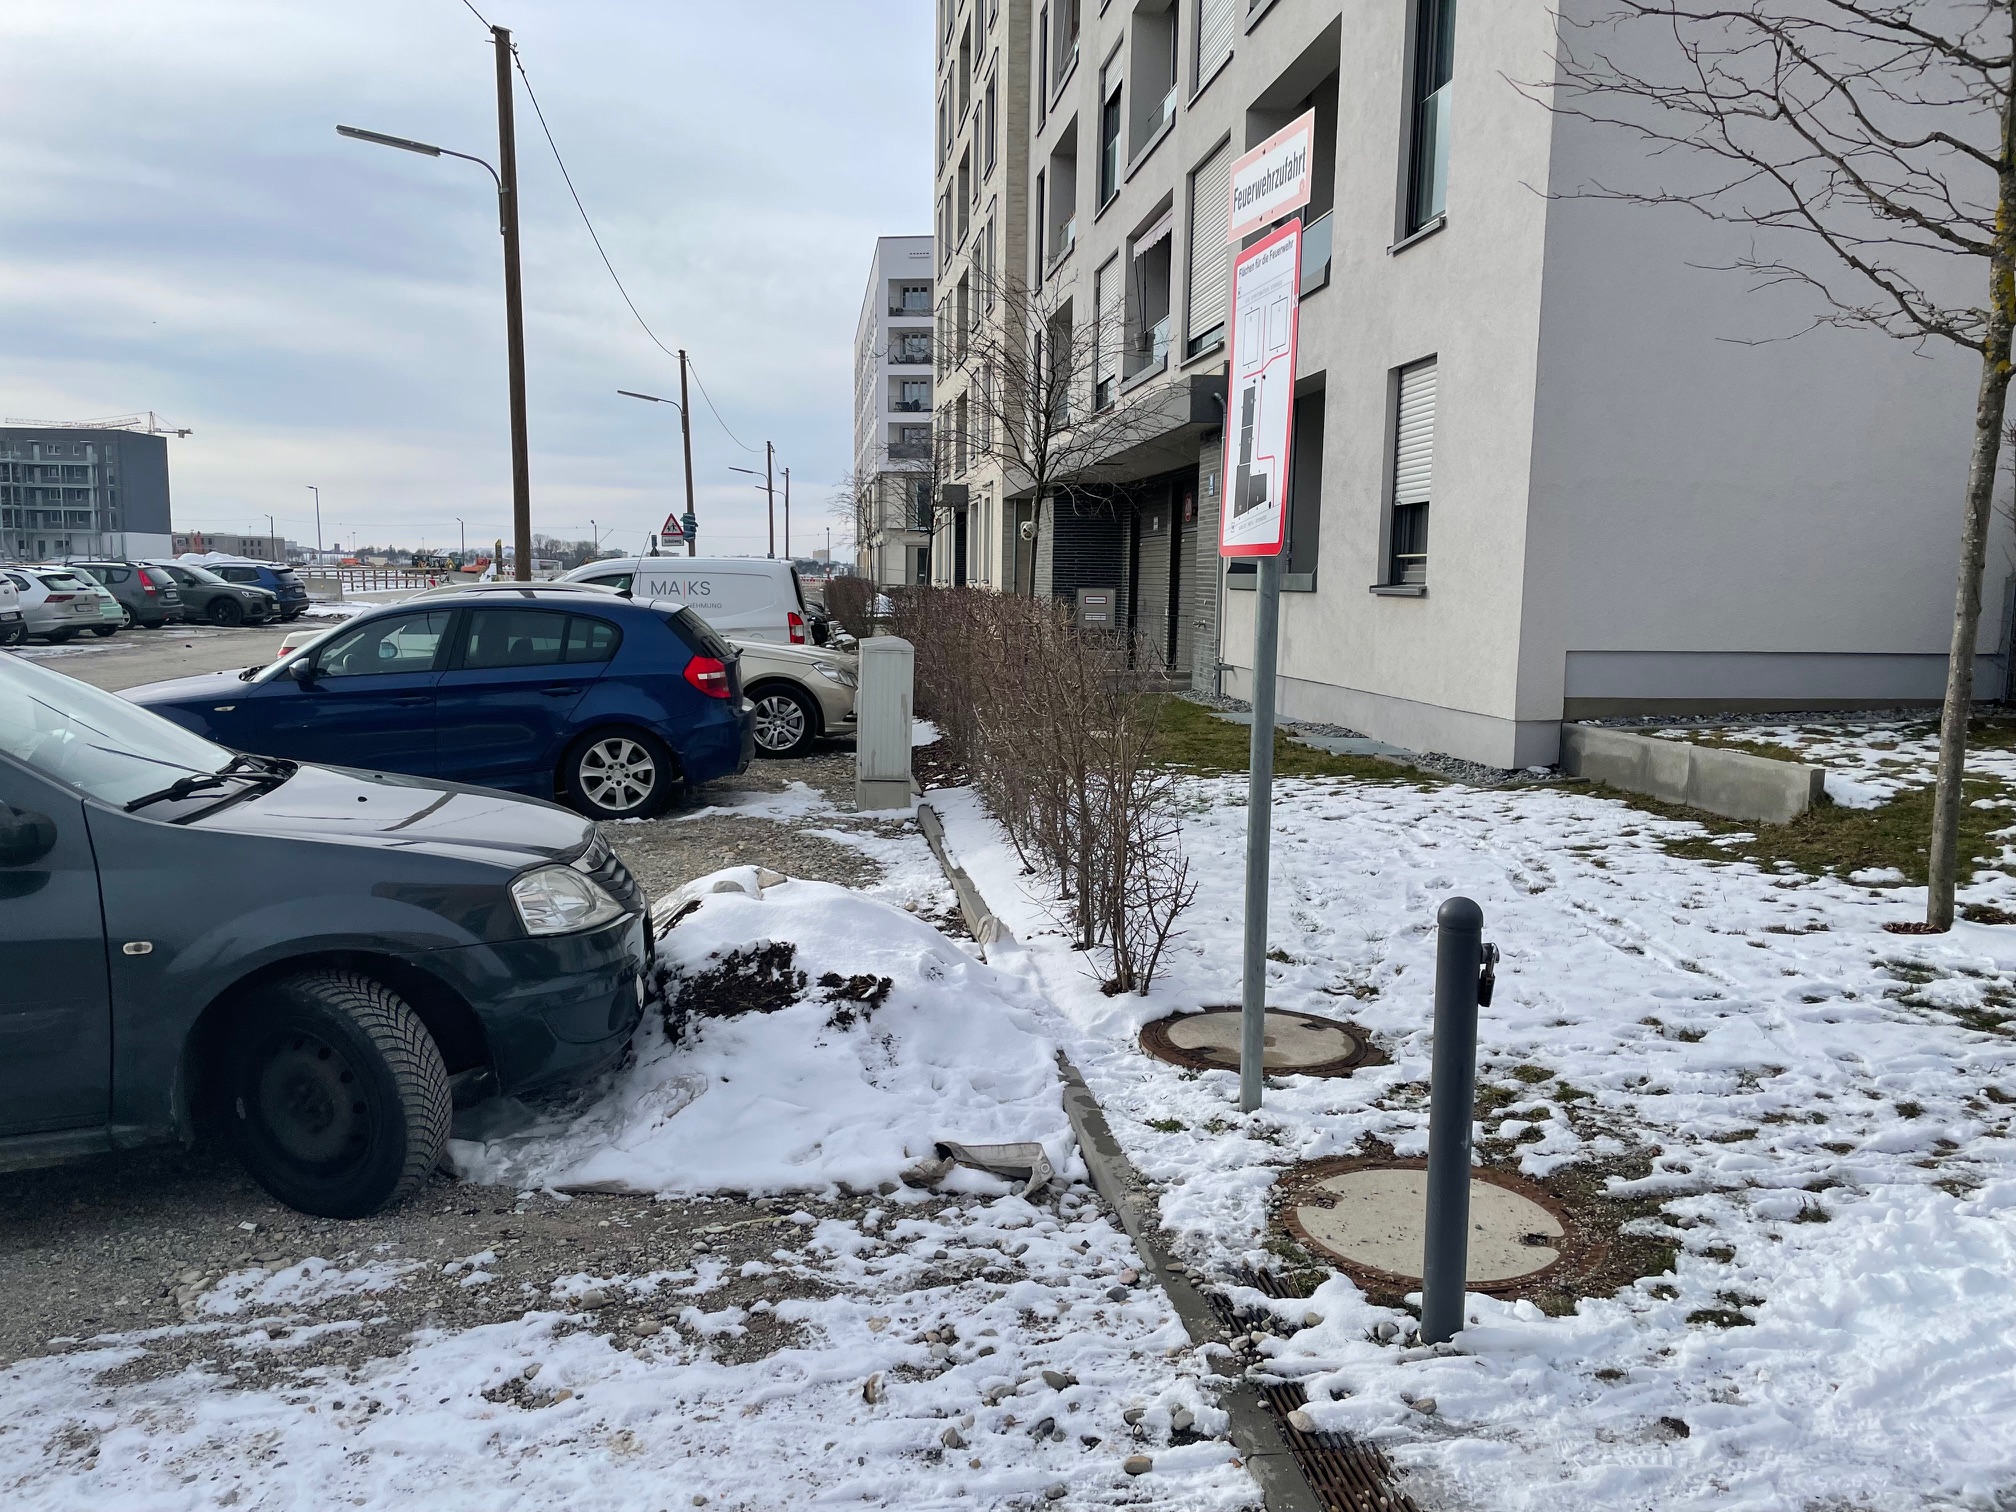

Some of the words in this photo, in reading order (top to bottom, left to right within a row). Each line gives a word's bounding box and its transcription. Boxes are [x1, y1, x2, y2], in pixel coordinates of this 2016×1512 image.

[1233, 146, 1306, 212] Feuerwehrzufahrt
[1239, 262, 1255, 278] Flächen
[1269, 239, 1294, 261] Feuerwehr
